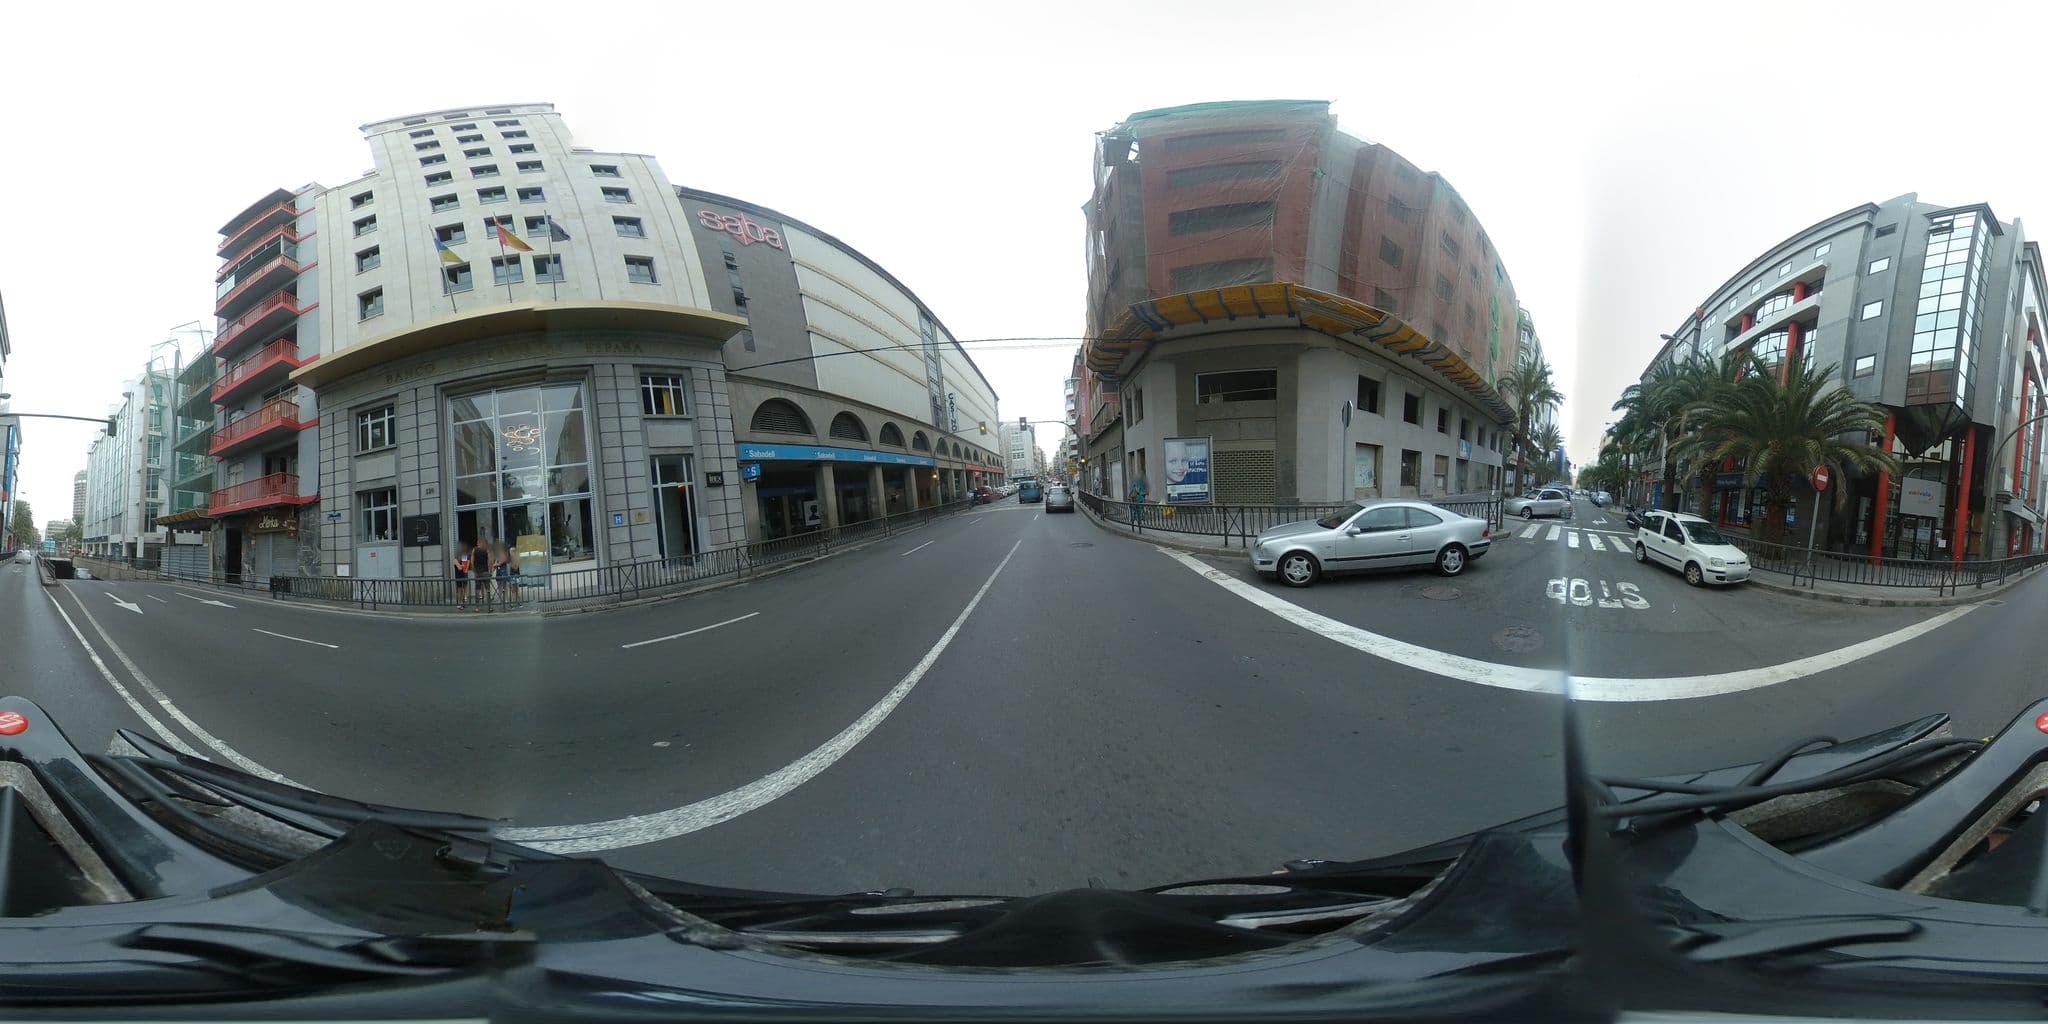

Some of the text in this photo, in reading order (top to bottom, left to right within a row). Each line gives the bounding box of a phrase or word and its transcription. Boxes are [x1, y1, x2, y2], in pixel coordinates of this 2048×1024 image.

[697, 210, 783, 249] saba
[948, 392, 957, 431] CASINO
[749, 449, 776, 458] Sabadell
[1545, 577, 1651, 610] STOP
